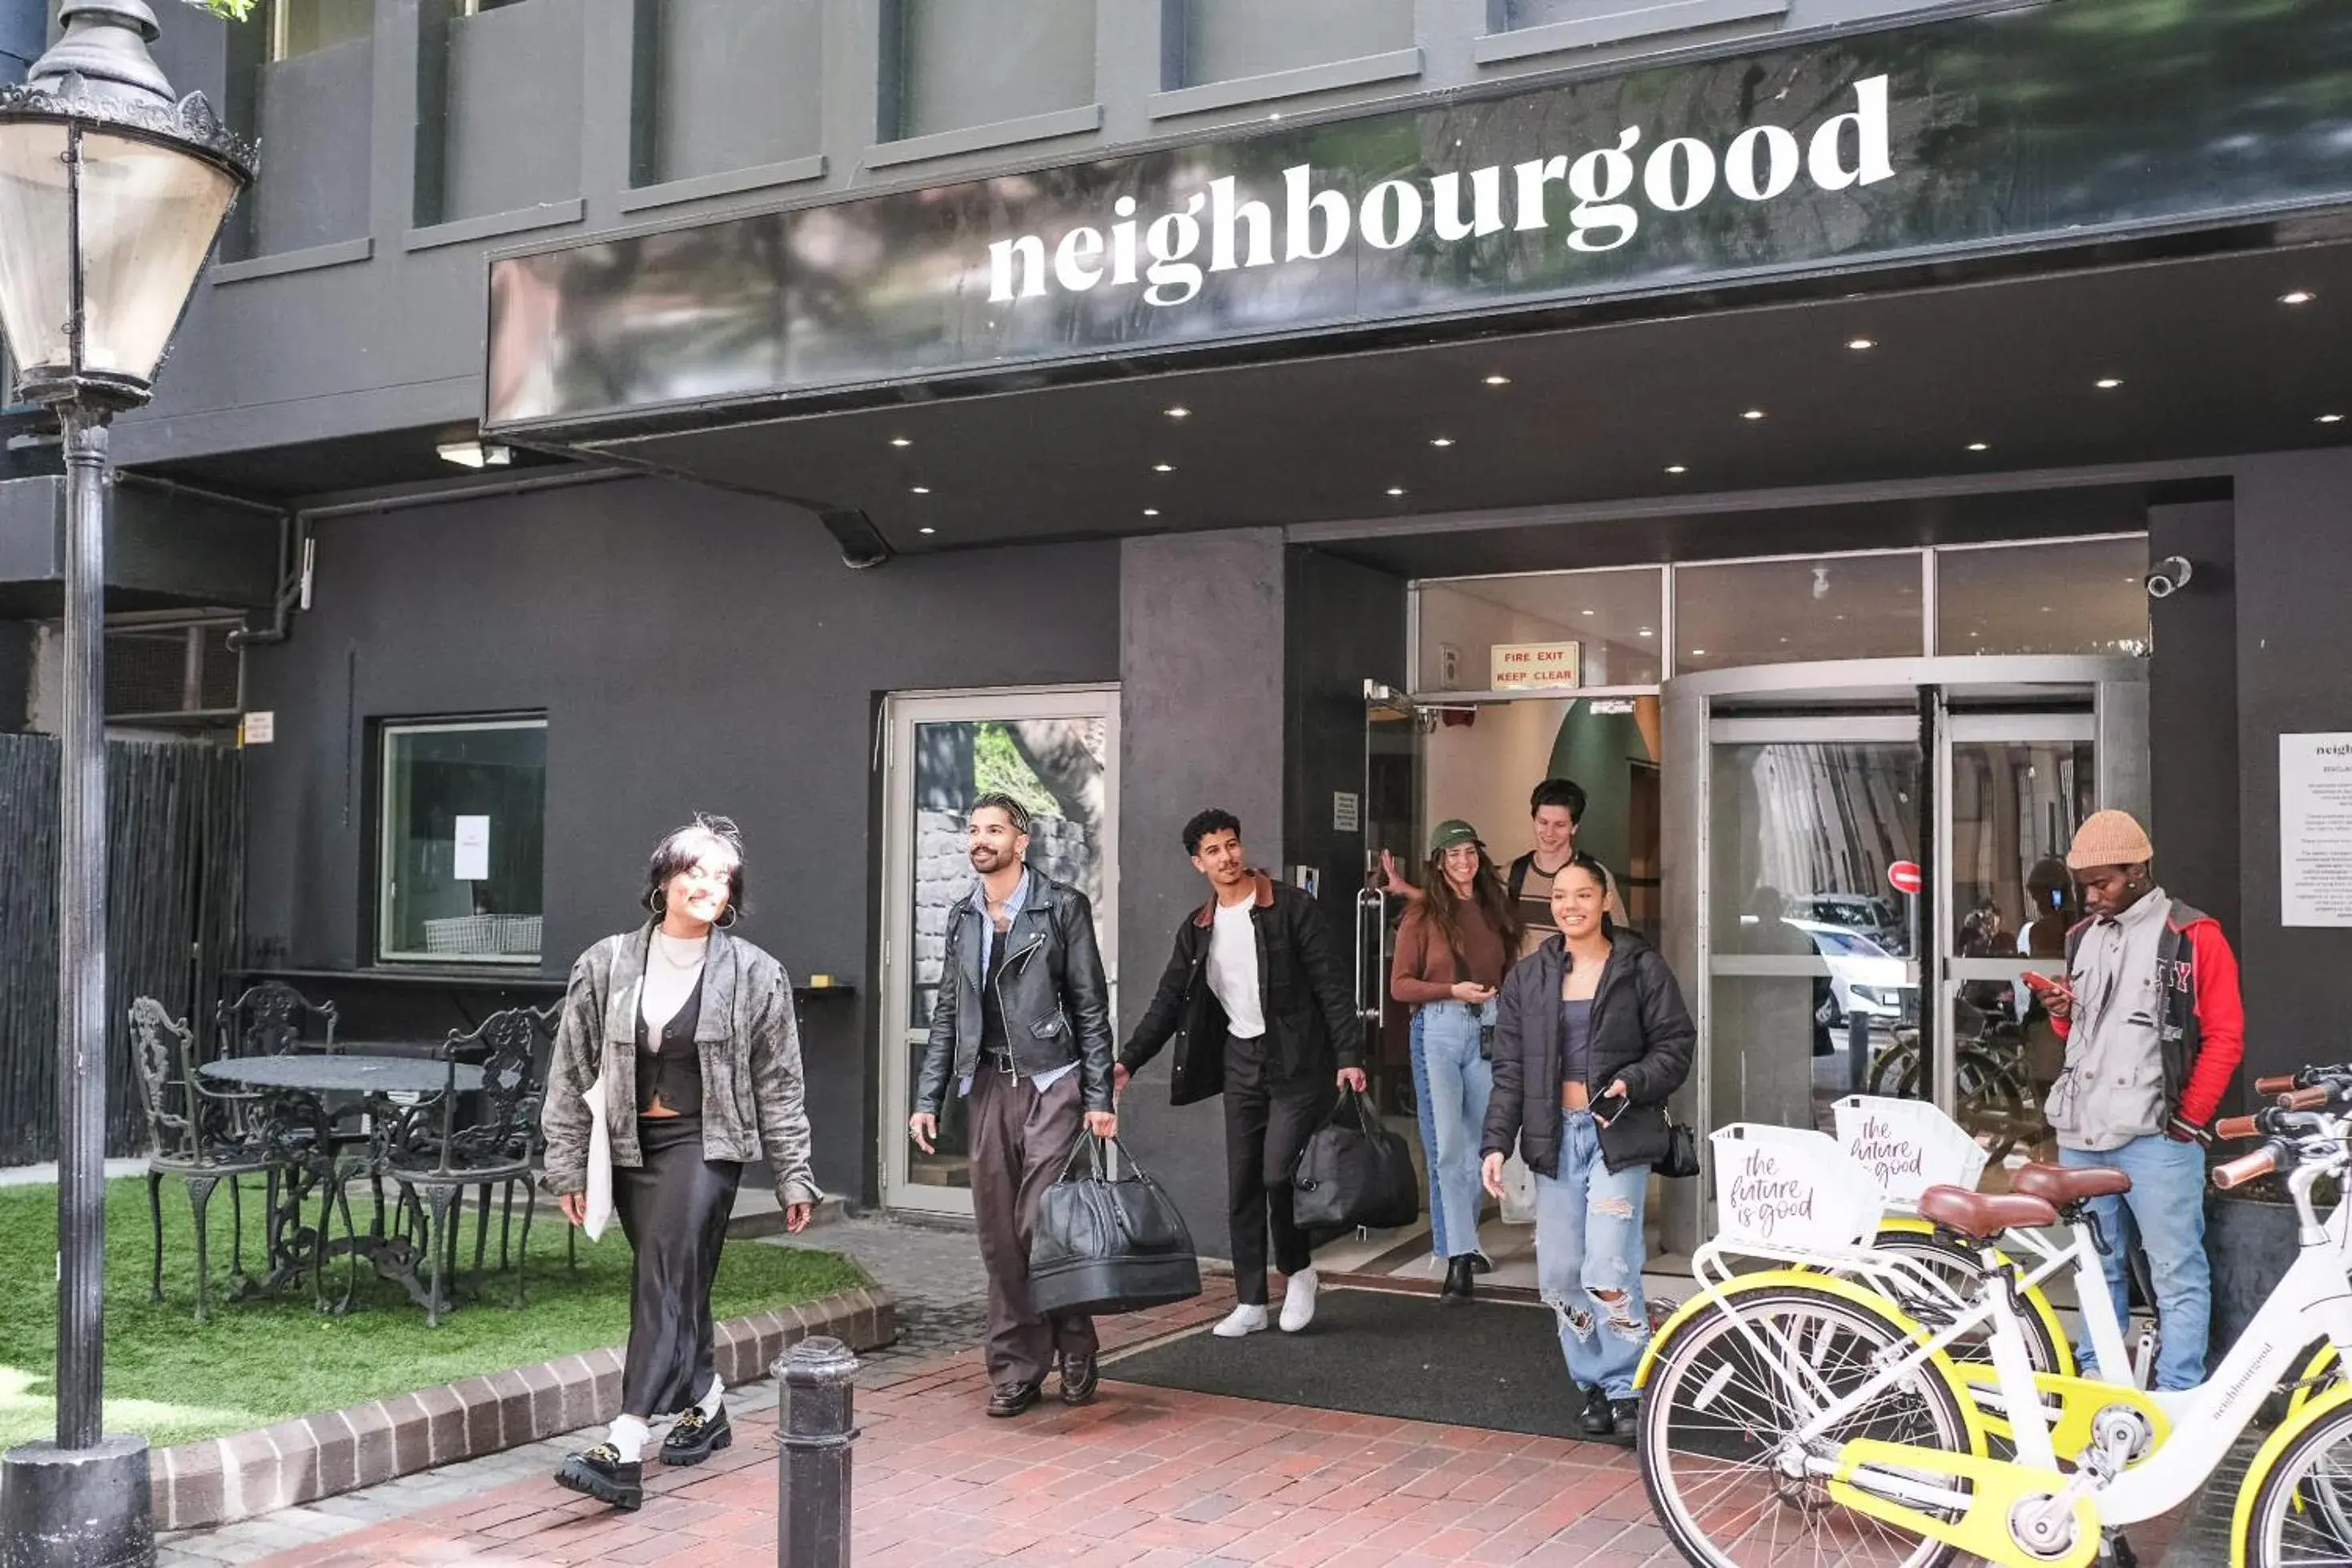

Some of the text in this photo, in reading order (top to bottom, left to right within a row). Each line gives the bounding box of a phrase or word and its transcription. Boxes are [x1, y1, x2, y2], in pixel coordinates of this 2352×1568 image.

[988, 74, 1896, 307] neighbourgood
[1504, 651, 1564, 662] FIRE EXIT
[1497, 670, 1571, 681] KEEP CLEAR
[1858, 1116, 1892, 1139] the
[1740, 1148, 1779, 1176] the
[1850, 1137, 1912, 1161] future
[1875, 1147, 1922, 1189] good
[1731, 1175, 1803, 1208] future
[1738, 1186, 1813, 1238] is good
[2213, 1342, 2274, 1420] neighbourgood
